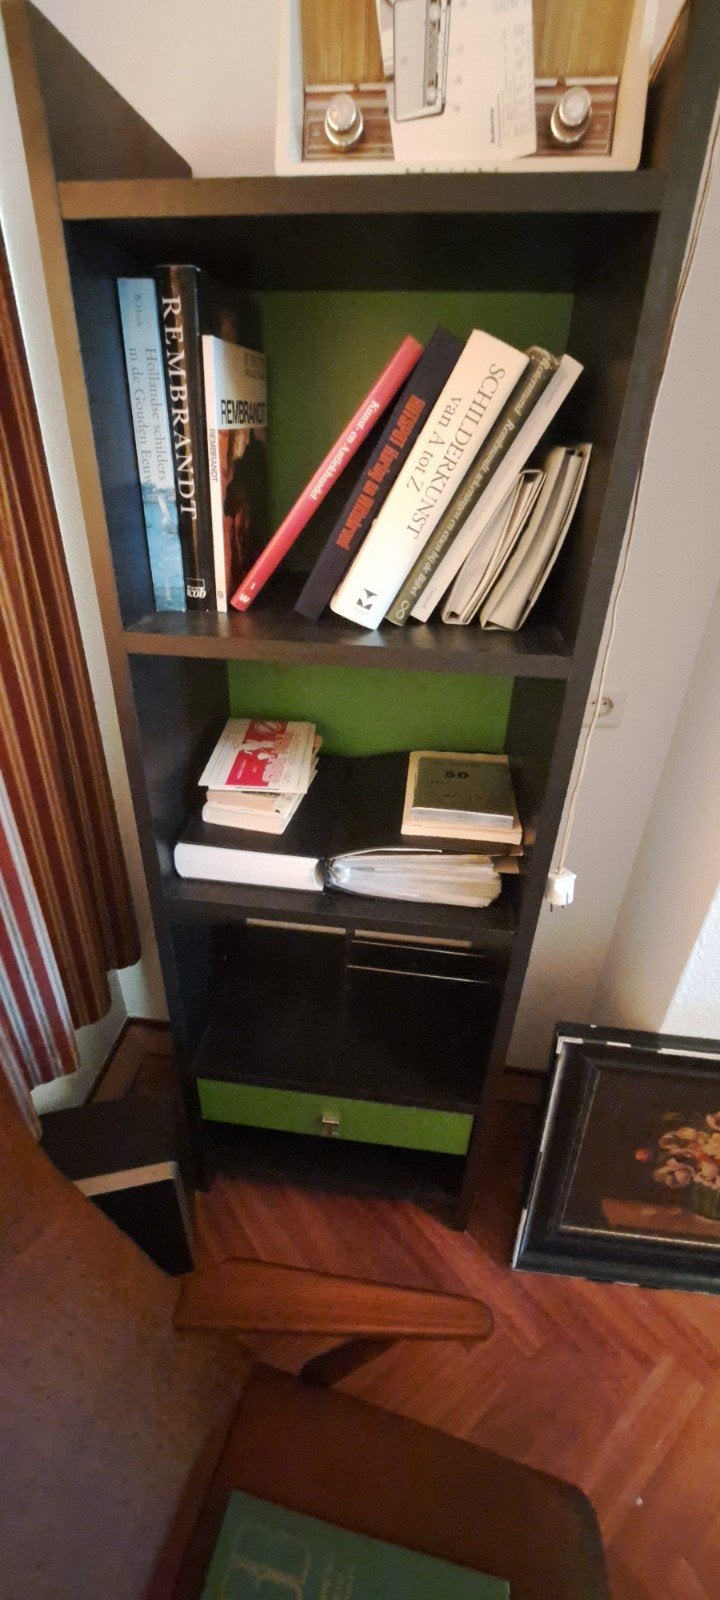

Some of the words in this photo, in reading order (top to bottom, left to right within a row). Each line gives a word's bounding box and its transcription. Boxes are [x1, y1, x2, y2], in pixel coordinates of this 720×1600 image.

[129, 347, 142, 361] in
[131, 367, 144, 384] de
[145, 348, 162, 420] Hollandse
[134, 388, 150, 445] Gouden
[161, 296, 198, 520] REMBRANDT
[220, 399, 266, 425] REMBRANDT
[356, 400, 380, 432] Kunst-
[438, 396, 462, 428] van
[153, 423, 169, 481] schilders
[347, 429, 358, 445] en
[406, 363, 507, 540] SCHILDERKUNST
[428, 431, 446, 447] A
[208, 428, 219, 483] REMBRANDT
[415, 450, 434, 475] tot
[309, 444, 352, 501] Antiekhandel
[406, 475, 425, 494] Z
